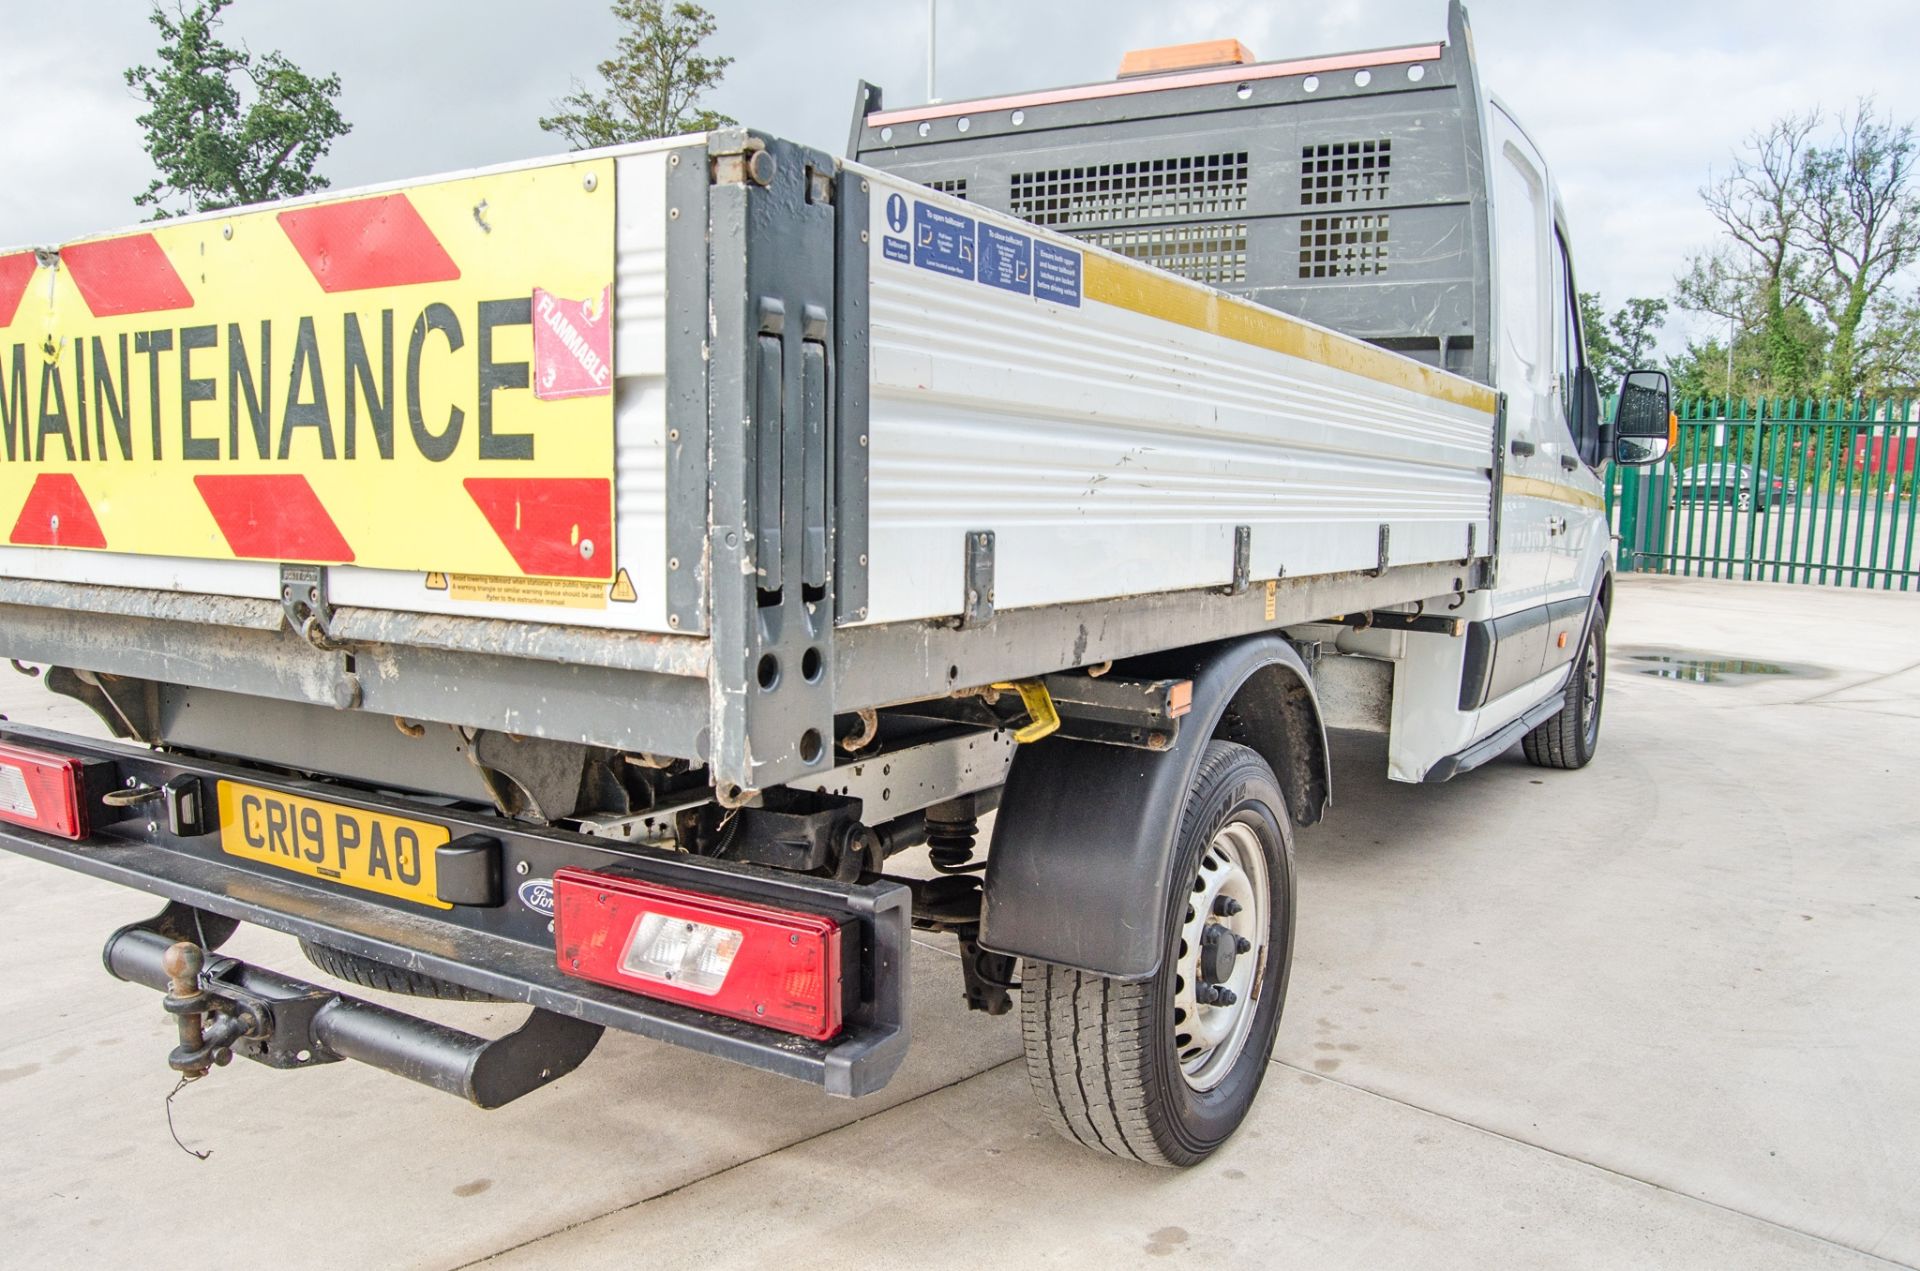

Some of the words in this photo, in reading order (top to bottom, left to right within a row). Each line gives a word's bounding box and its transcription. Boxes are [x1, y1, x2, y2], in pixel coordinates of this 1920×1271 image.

[886, 248, 898, 257] lower
[888, 239, 907, 250] Tailboard
[1040, 250, 1054, 260] Ensure
[1048, 262, 1059, 271] lower
[1059, 266, 1075, 277] tailboard
[1037, 280, 1050, 290] before
[1050, 284, 1064, 295] driving
[1064, 288, 1077, 297] vehicle
[537, 294, 610, 386] FLAMMABLE
[0, 297, 535, 462] MAINTENANCE
[542, 366, 557, 388] 3
[241, 794, 324, 863] CR19
[335, 813, 421, 886] PAO
[530, 886, 554, 908] For
